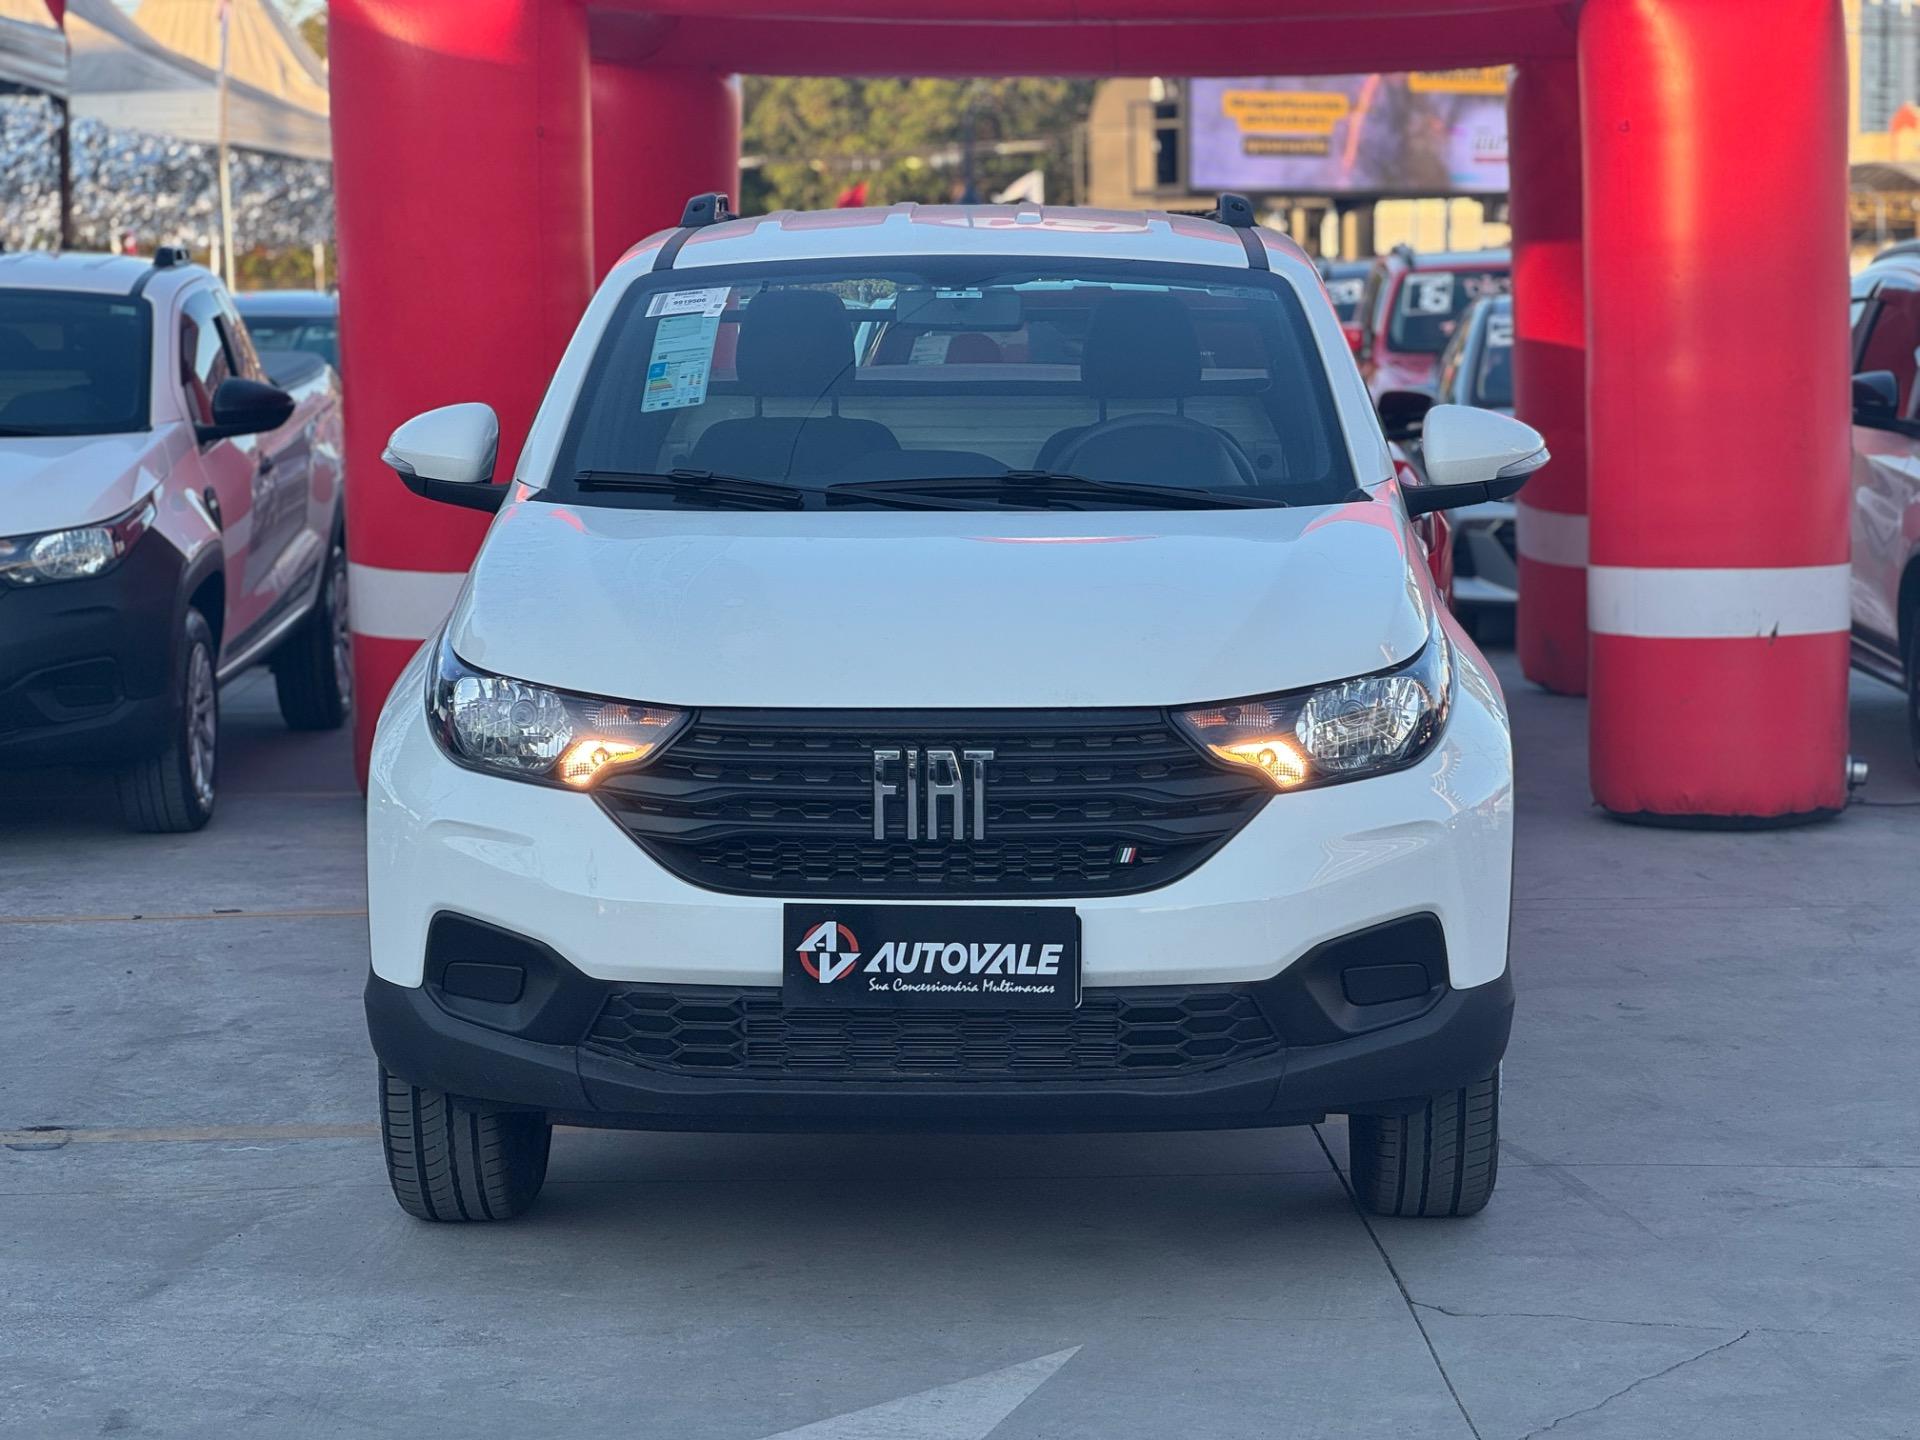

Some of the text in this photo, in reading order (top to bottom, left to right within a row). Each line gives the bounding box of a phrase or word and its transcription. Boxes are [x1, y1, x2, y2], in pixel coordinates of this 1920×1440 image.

[874, 750, 994, 840] FIAT
[863, 942, 1064, 975] AUTOVALE
[869, 977, 889, 991] Sua
[982, 978, 1055, 993] Multimarcas
